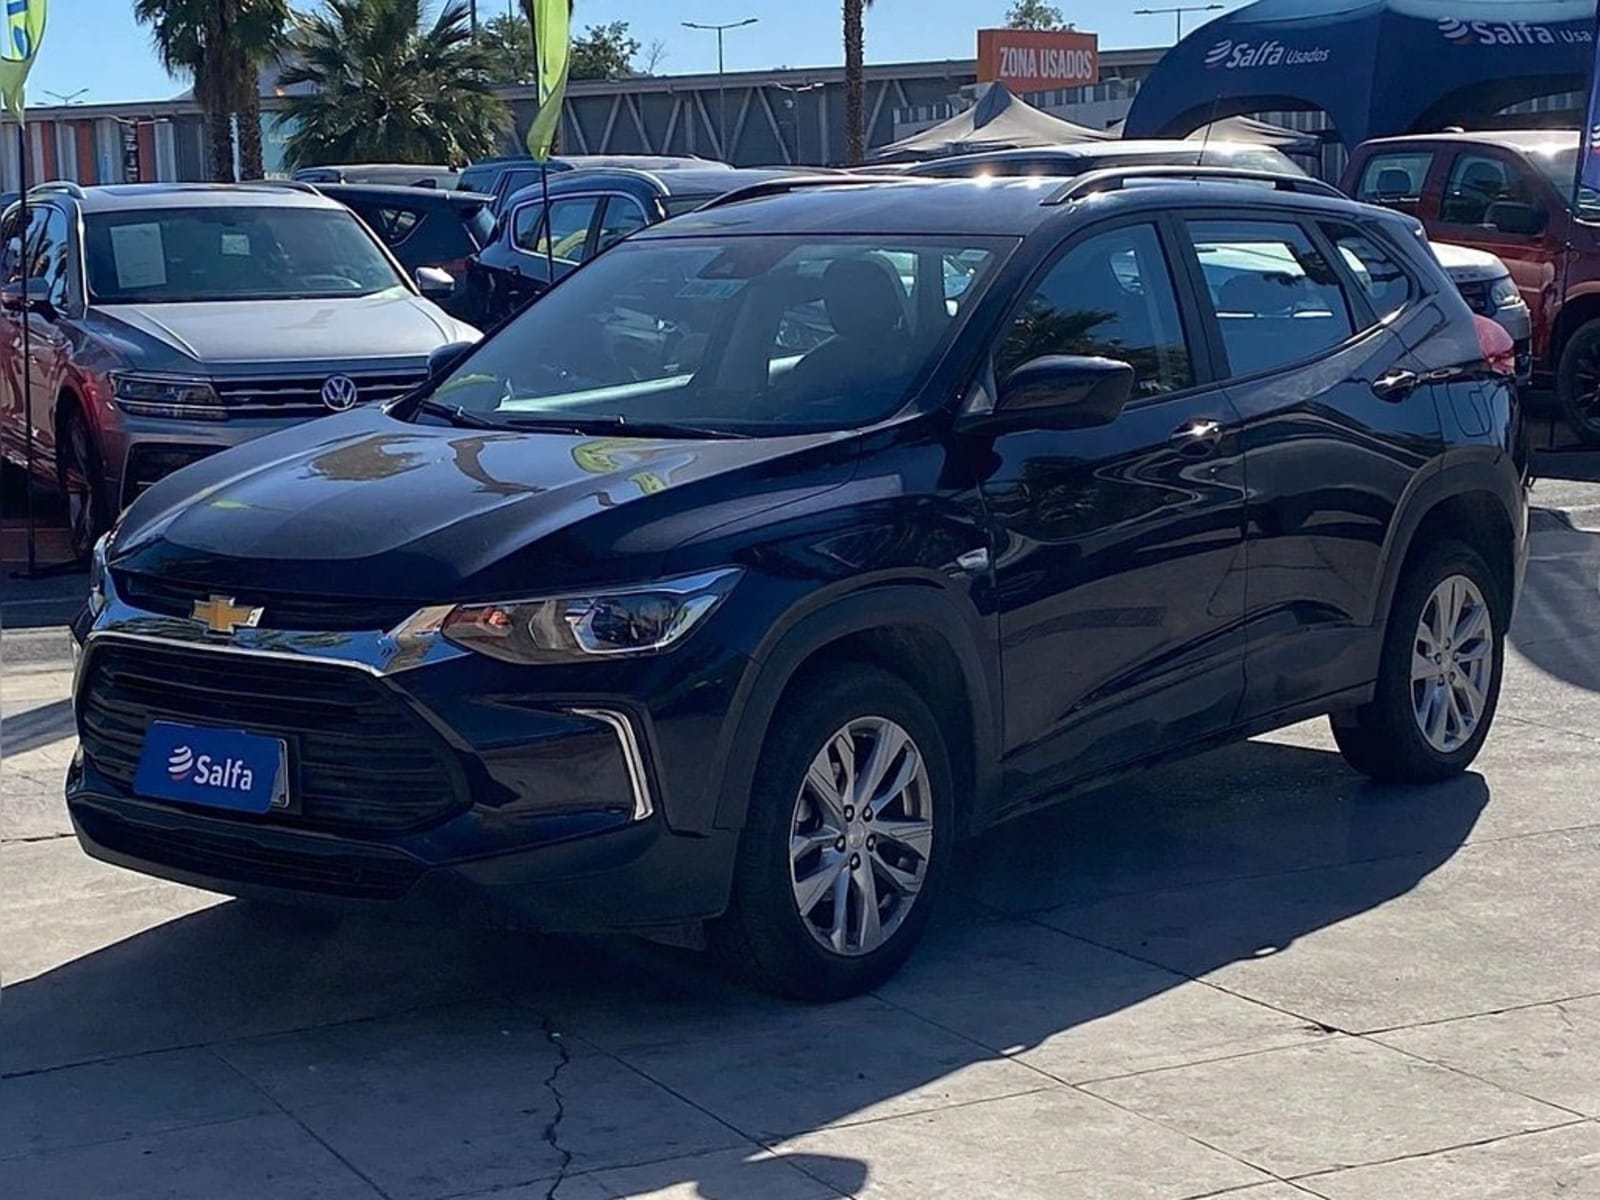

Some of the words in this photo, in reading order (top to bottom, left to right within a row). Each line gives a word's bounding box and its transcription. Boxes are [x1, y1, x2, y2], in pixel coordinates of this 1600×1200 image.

[1471, 20, 1554, 45] Salfa
[1560, 29, 1594, 43] Usa
[1000, 47, 1037, 78] ZONA
[1040, 49, 1092, 79] USADOS
[1226, 41, 1284, 68] Salfa
[1286, 46, 1330, 64] Usados
[193, 755, 253, 791] Salfa
